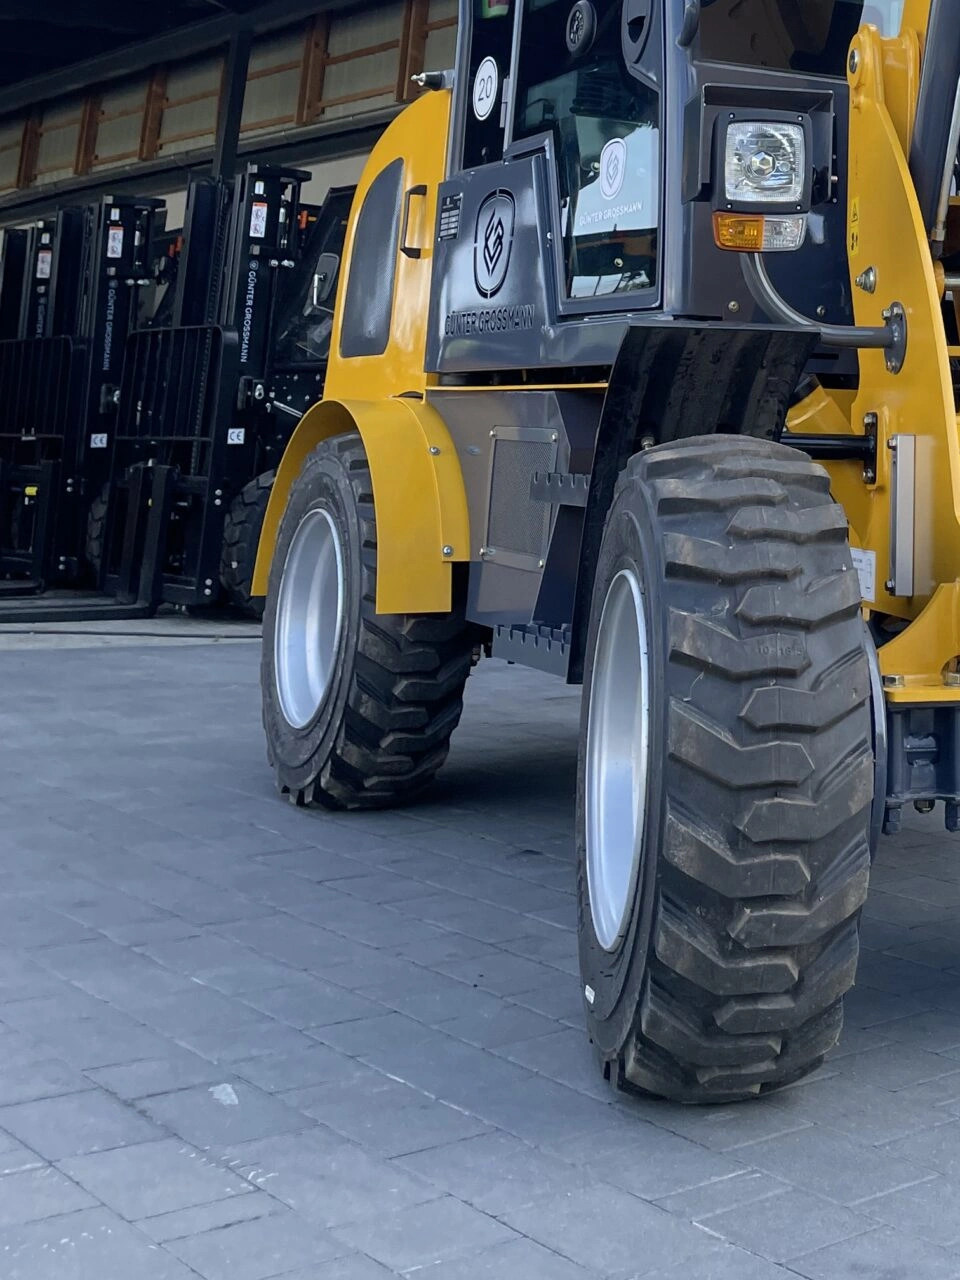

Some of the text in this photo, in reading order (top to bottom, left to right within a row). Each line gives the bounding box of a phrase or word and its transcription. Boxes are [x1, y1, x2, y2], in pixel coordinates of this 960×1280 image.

[478, 75, 493, 102] 20
[603, 201, 643, 220] GROSSMANN
[240, 270, 257, 363] GÜNTER GROSSMANN
[445, 304, 535, 336] GÜNTER GROSSMANN
